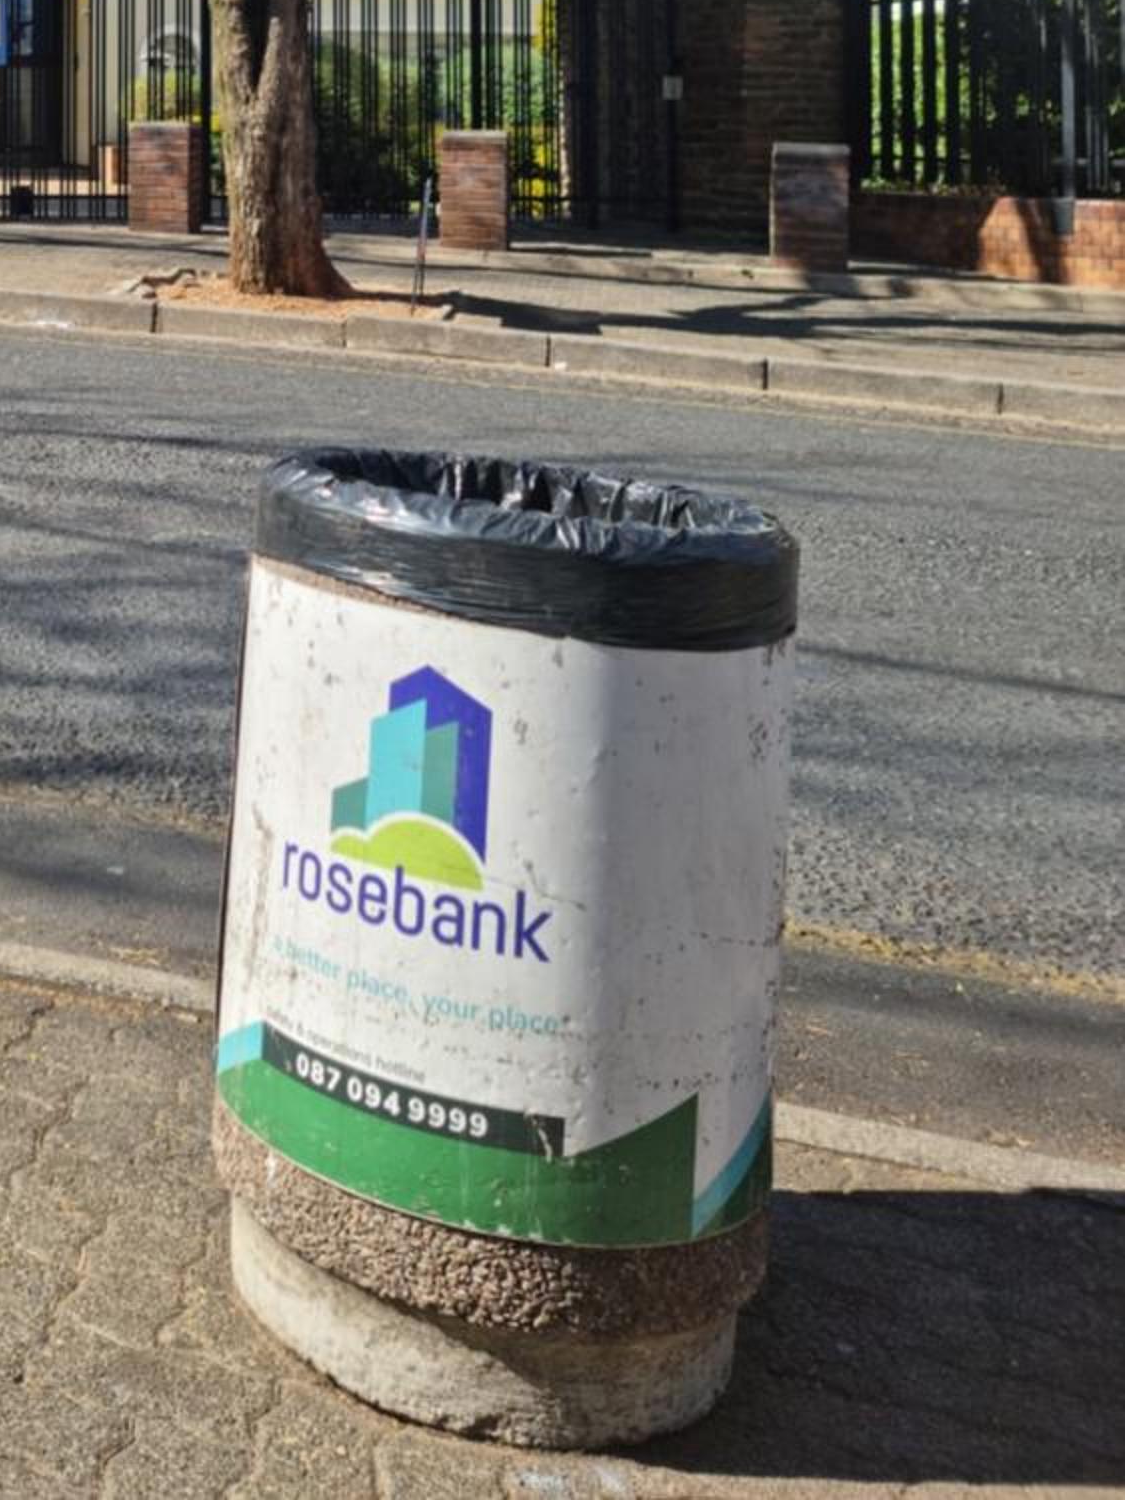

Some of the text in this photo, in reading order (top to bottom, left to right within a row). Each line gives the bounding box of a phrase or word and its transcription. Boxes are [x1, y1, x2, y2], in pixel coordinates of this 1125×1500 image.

[282, 841, 552, 963] rosebank
[286, 936, 341, 980] better
[422, 993, 477, 1027] your
[295, 1052, 488, 1138] 087 094 9999
